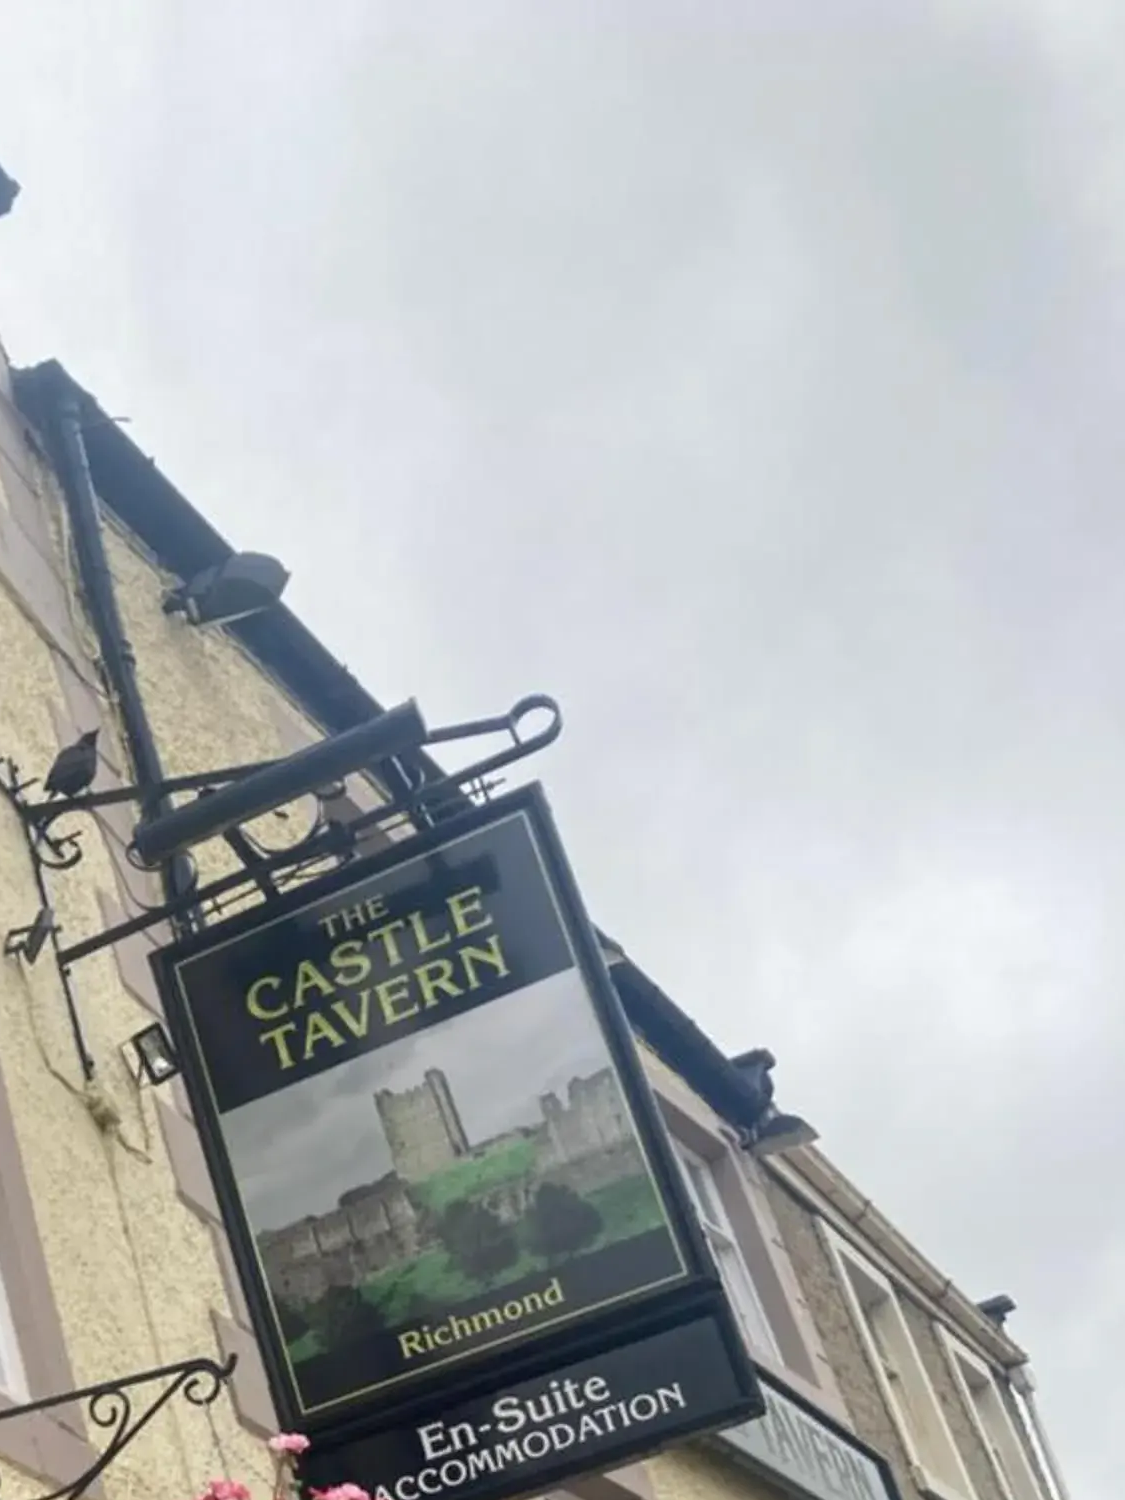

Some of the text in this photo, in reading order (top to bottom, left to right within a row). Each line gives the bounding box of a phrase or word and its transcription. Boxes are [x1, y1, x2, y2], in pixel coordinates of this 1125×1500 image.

[246, 885, 494, 1021] CASTLE
[318, 894, 390, 939] THE
[259, 934, 511, 1070] TAVERN
[397, 1277, 566, 1359] Richmond
[416, 1374, 611, 1461] En-Suite
